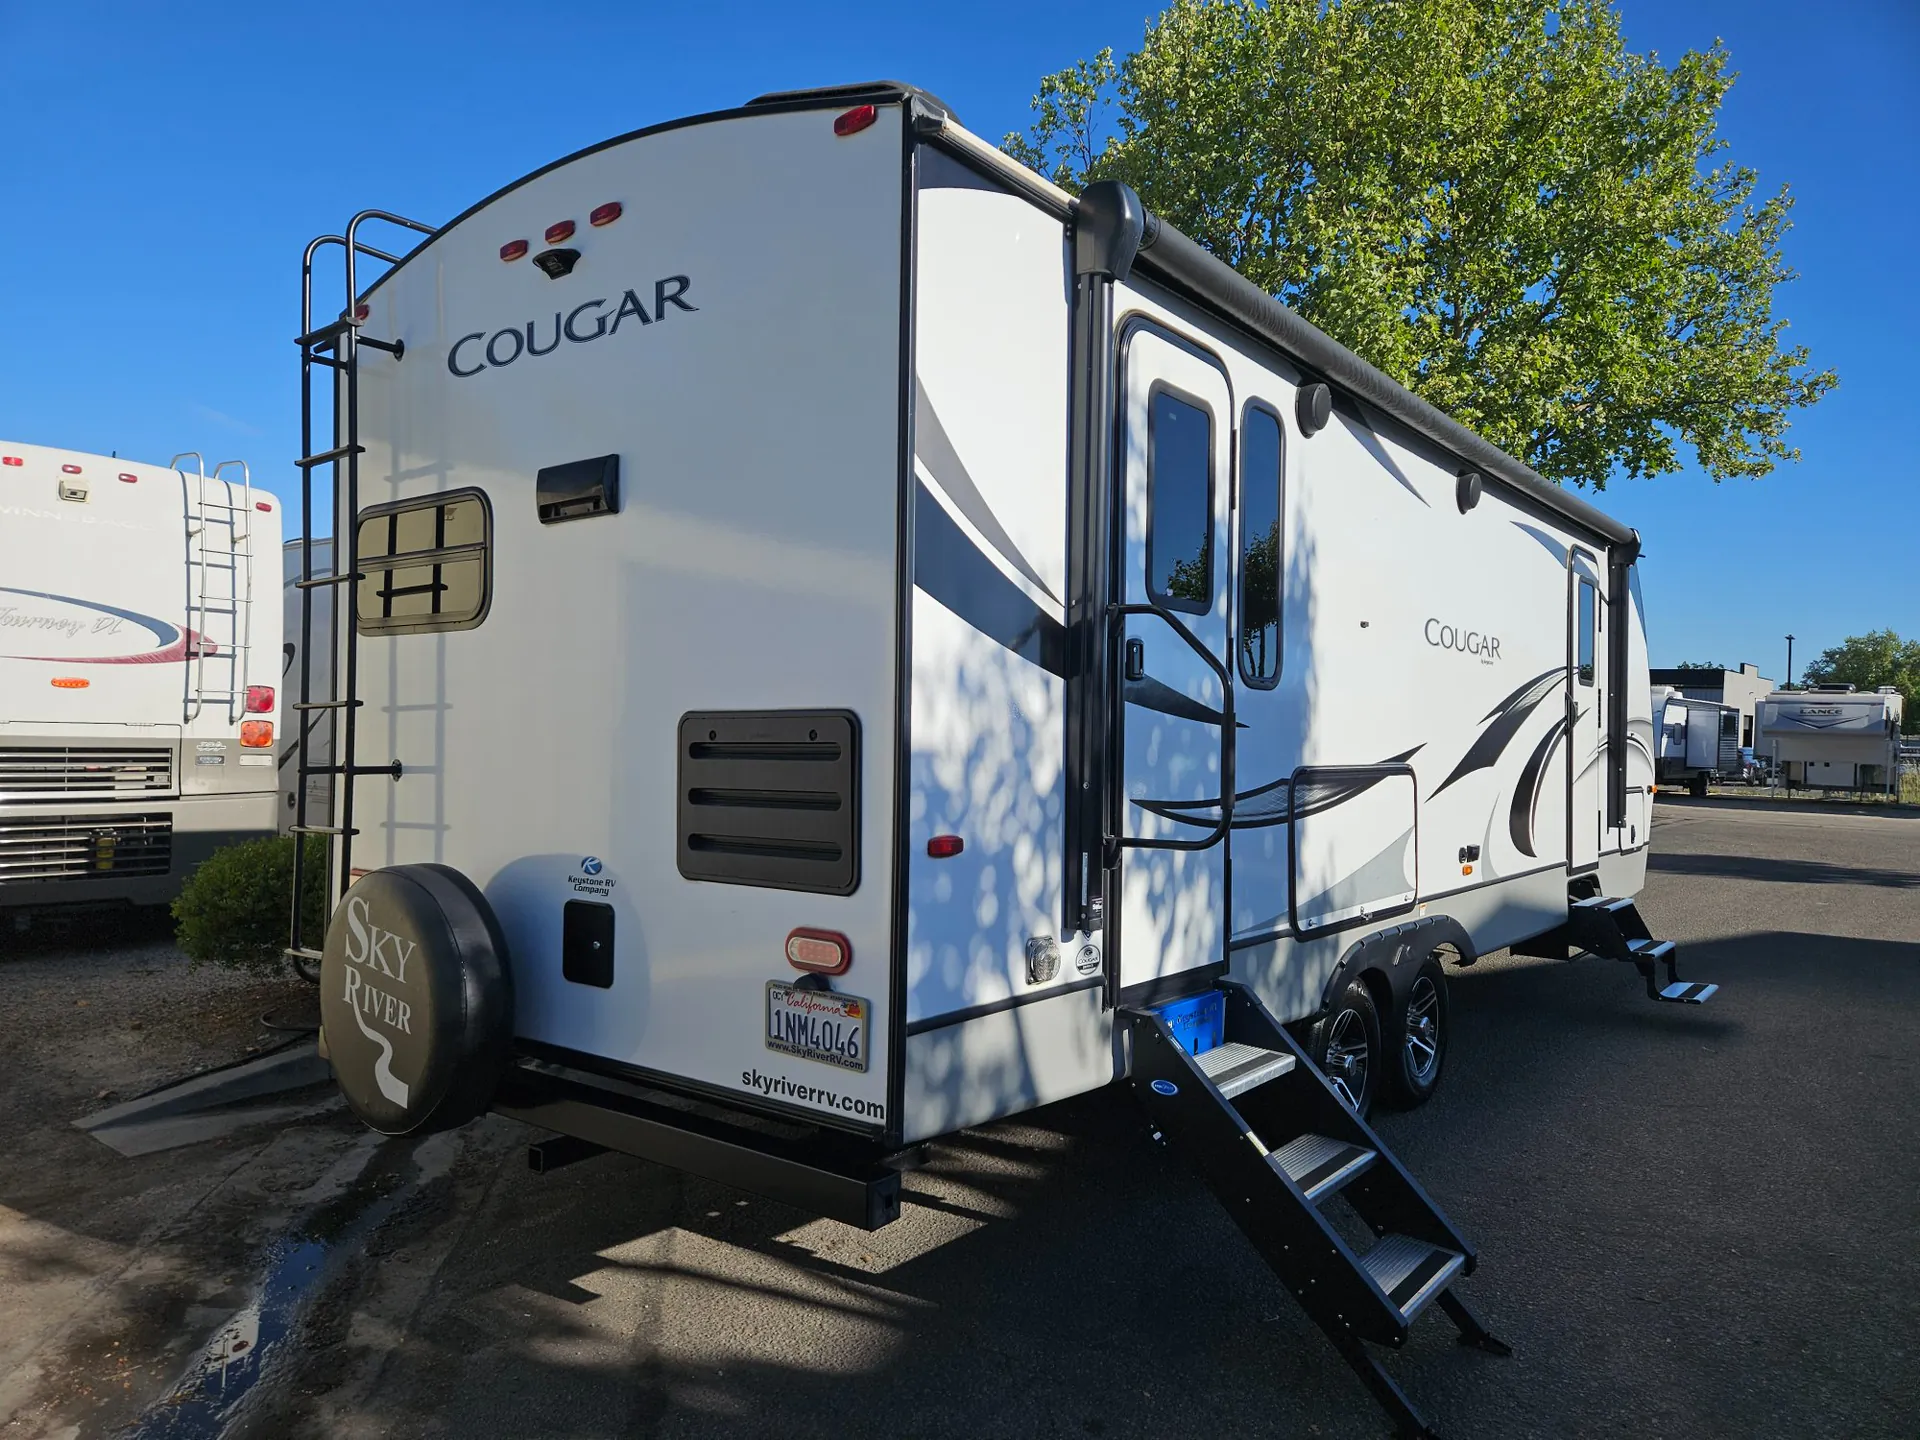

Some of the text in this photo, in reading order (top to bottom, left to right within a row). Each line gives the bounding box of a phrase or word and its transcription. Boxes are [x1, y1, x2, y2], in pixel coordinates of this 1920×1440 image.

[447, 274, 700, 378] COUGAR
[1424, 617, 1502, 660] COUGAR
[568, 875, 617, 888] Keystone RV
[573, 884, 610, 897] Company
[344, 896, 416, 984] SKY
[342, 964, 412, 1036] RIVER
[786, 991, 848, 1018] California
[767, 1039, 864, 1071] www.SkyRiverRV.com
[773, 1009, 860, 1059] 1NM4046
[742, 1068, 885, 1120] skyriverrv.com
